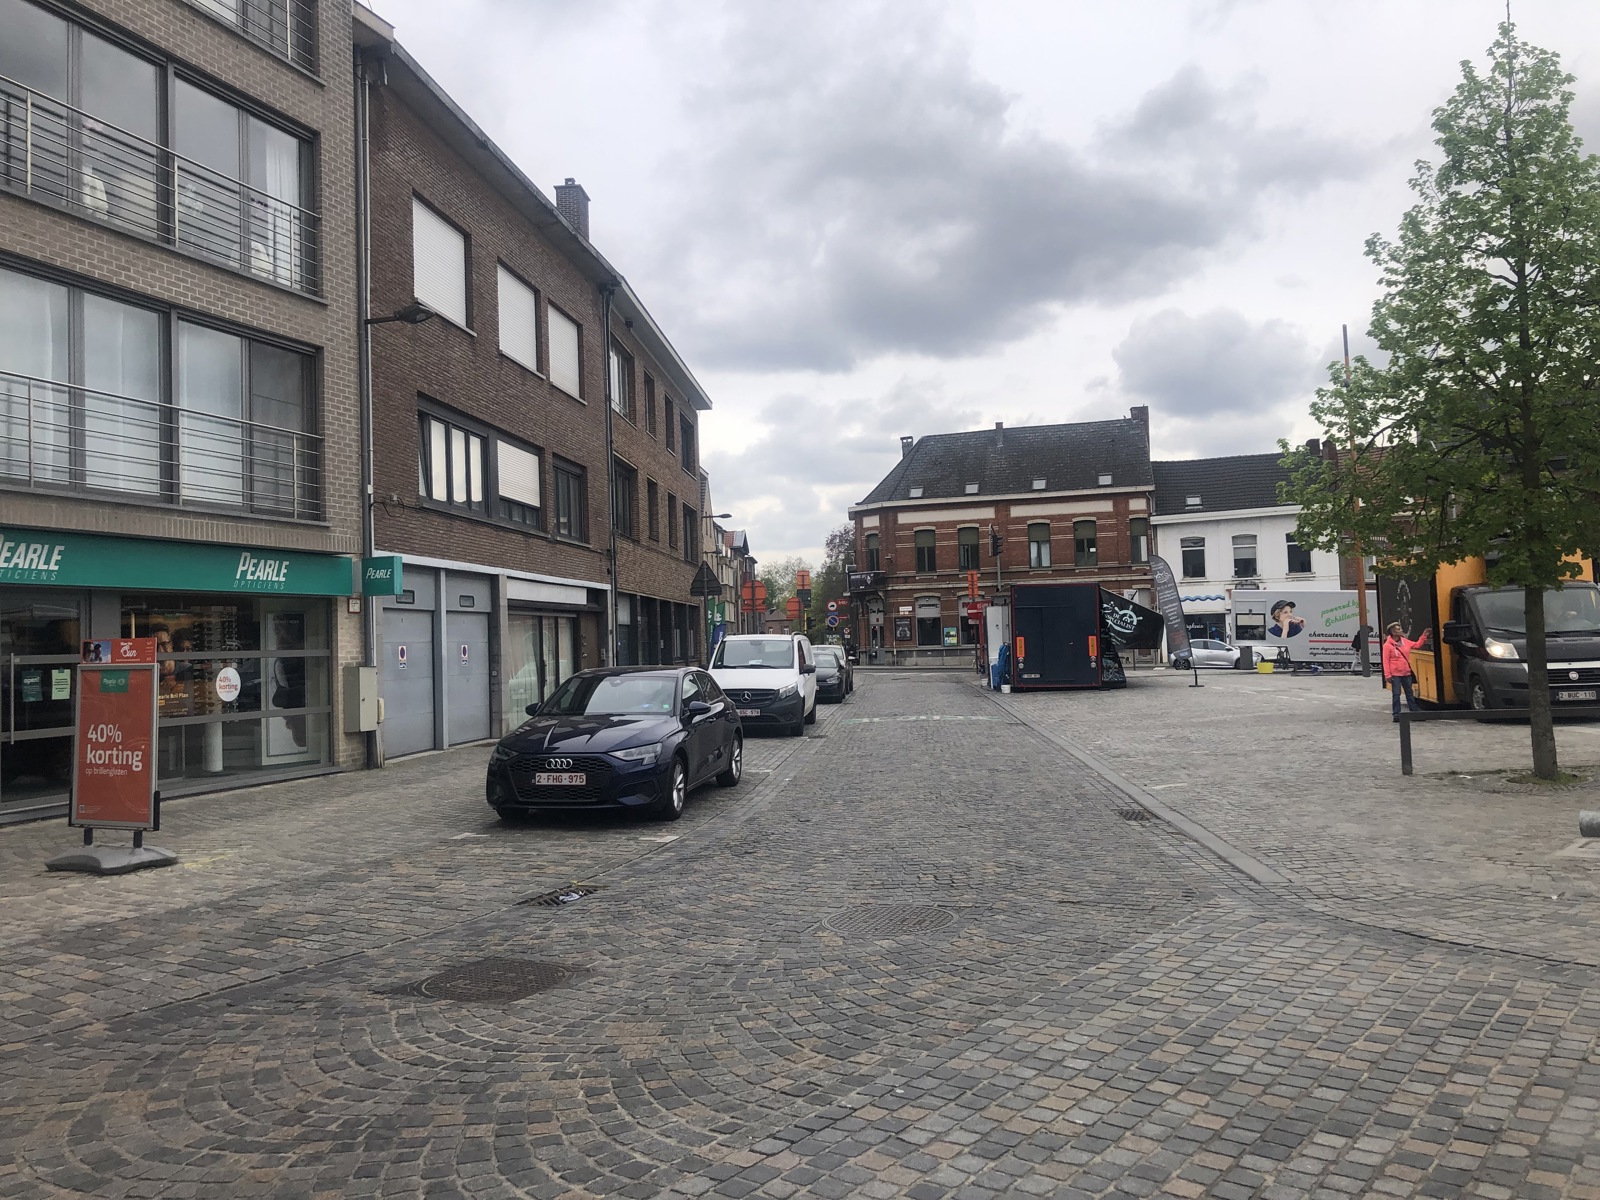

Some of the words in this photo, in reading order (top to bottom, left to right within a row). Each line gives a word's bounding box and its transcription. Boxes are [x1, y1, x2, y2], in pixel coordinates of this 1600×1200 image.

[235, 552, 289, 582] PEARLE
[0, 570, 57, 580] TICIENS
[366, 567, 392, 579] PEARLE
[233, 580, 285, 590] OPTICIENS
[1321, 601, 1350, 618] powered
[219, 683, 238, 691] korting
[87, 723, 123, 743] 40%
[86, 768, 93, 776] op
[537, 774, 585, 784] 2-FHG-975
